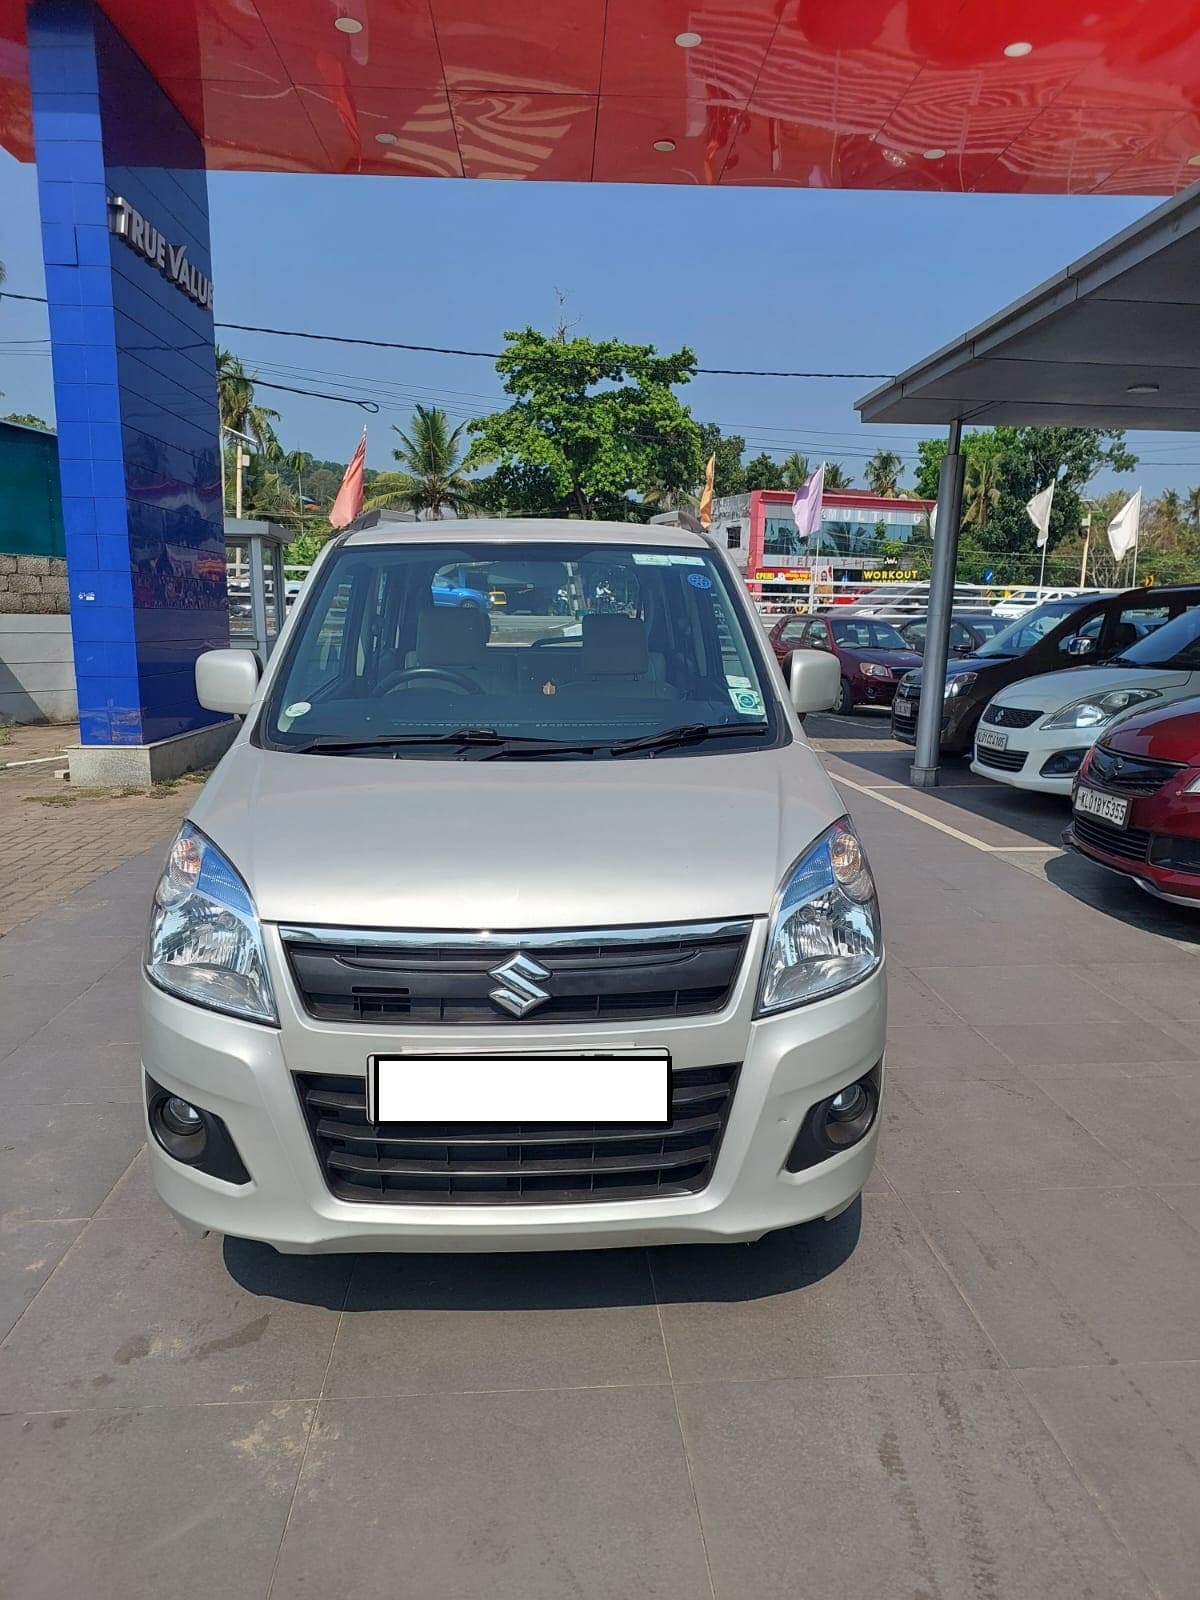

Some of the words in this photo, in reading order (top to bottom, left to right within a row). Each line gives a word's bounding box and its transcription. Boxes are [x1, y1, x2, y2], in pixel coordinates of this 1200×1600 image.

[107, 196, 166, 268] TRUE
[168, 244, 214, 310] VALUE
[829, 508, 893, 523] MULTI
[863, 570, 919, 580] WORKOUT
[1081, 791, 1127, 821] KL01BY5355
